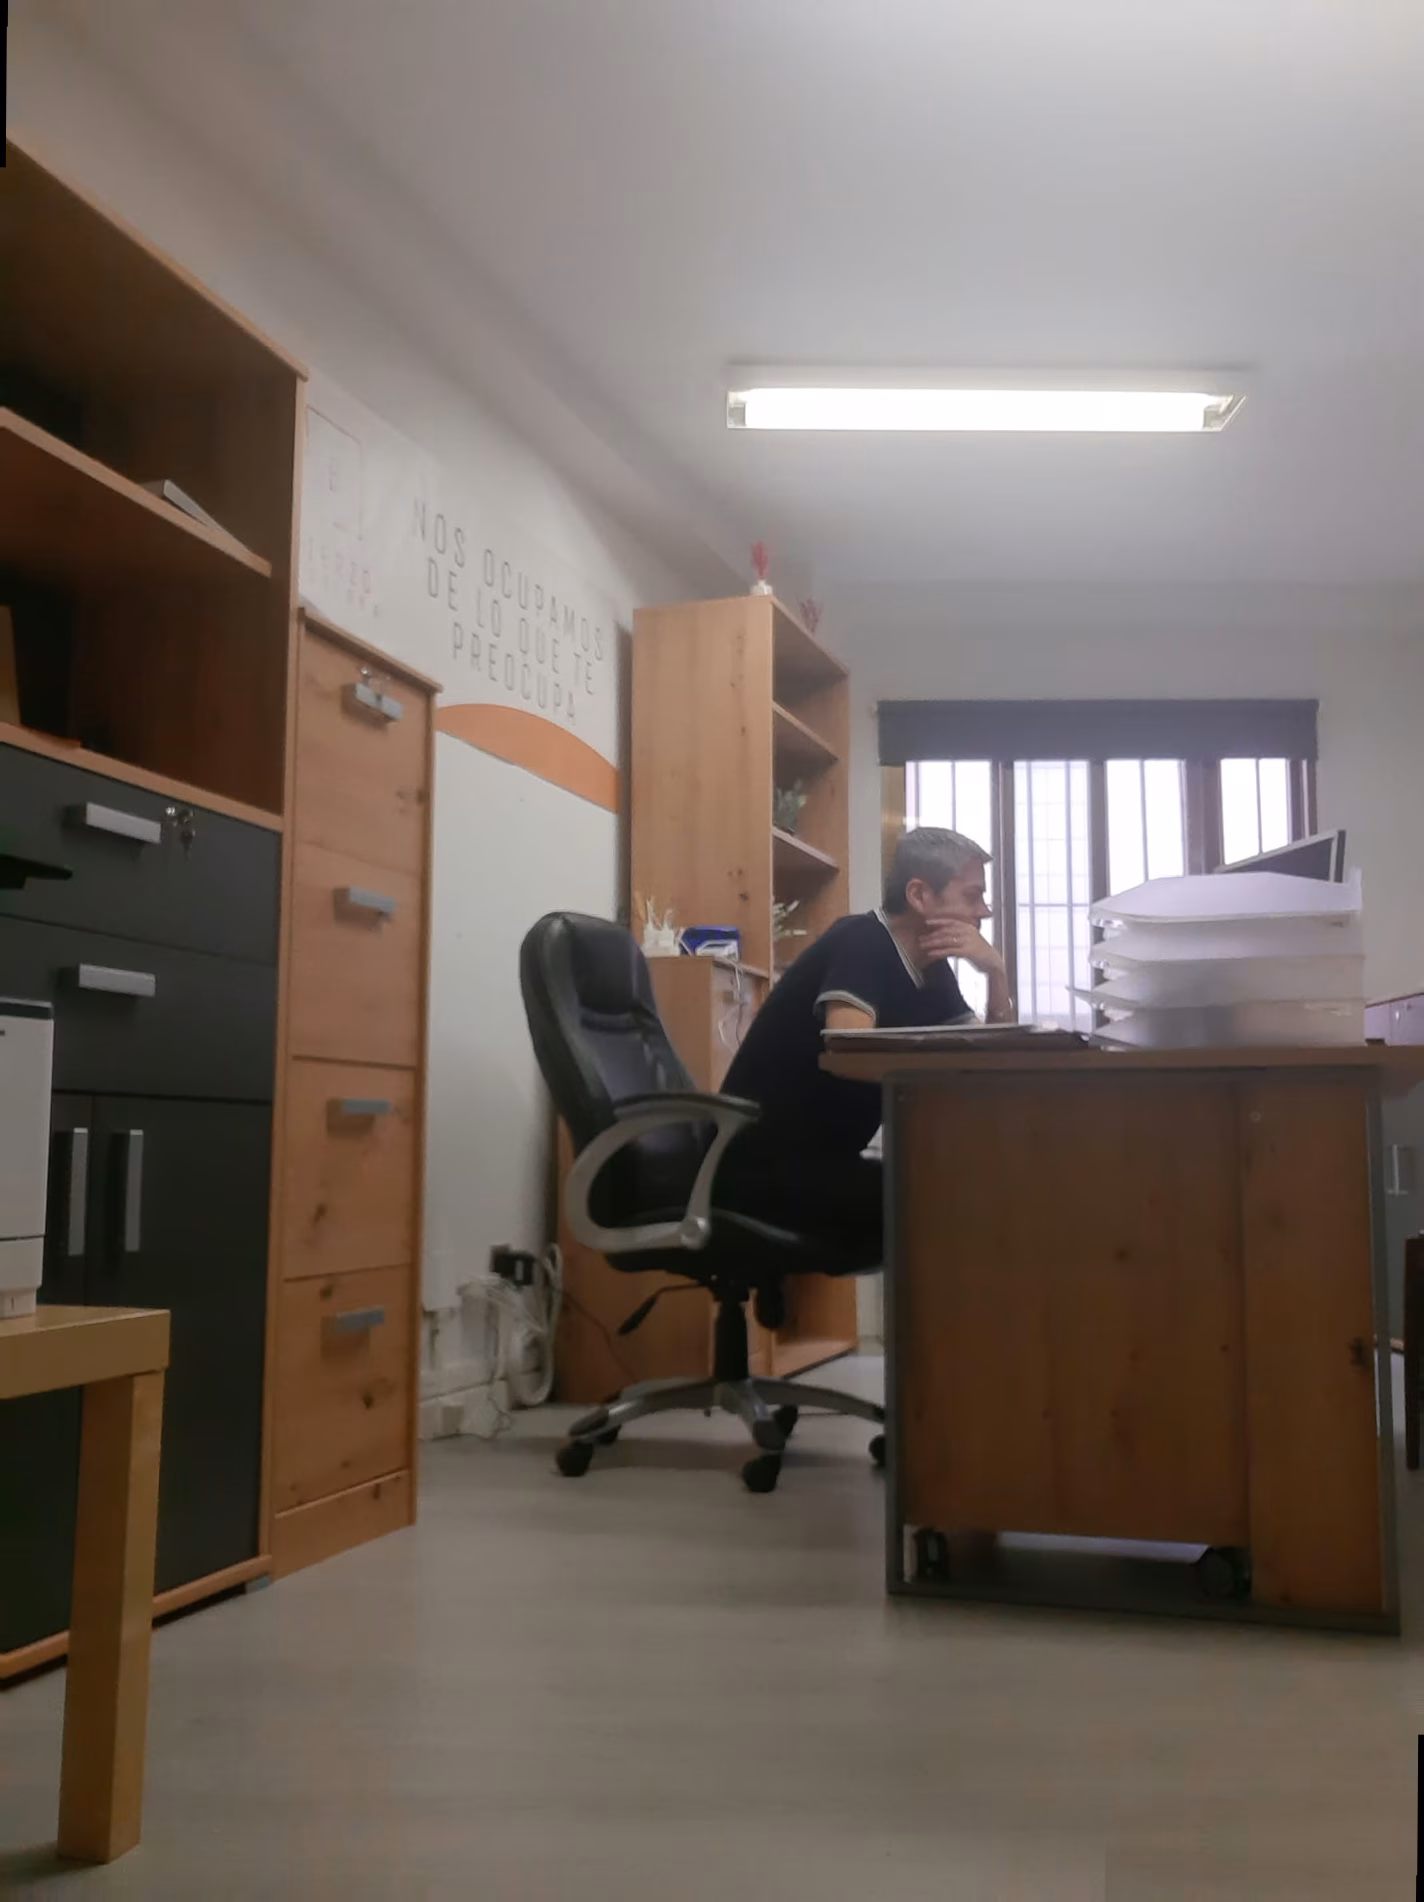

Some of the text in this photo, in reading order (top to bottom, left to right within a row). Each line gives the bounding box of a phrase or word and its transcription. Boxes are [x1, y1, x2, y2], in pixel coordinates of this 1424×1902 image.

[412, 497, 464, 568] NOS
[483, 548, 602, 662] OCUPAMOS
[427, 556, 458, 611] DE
[476, 587, 501, 638] LO
[518, 616, 559, 674] QUE
[572, 651, 594, 695] TE
[452, 621, 575, 726] PREOCUPA
